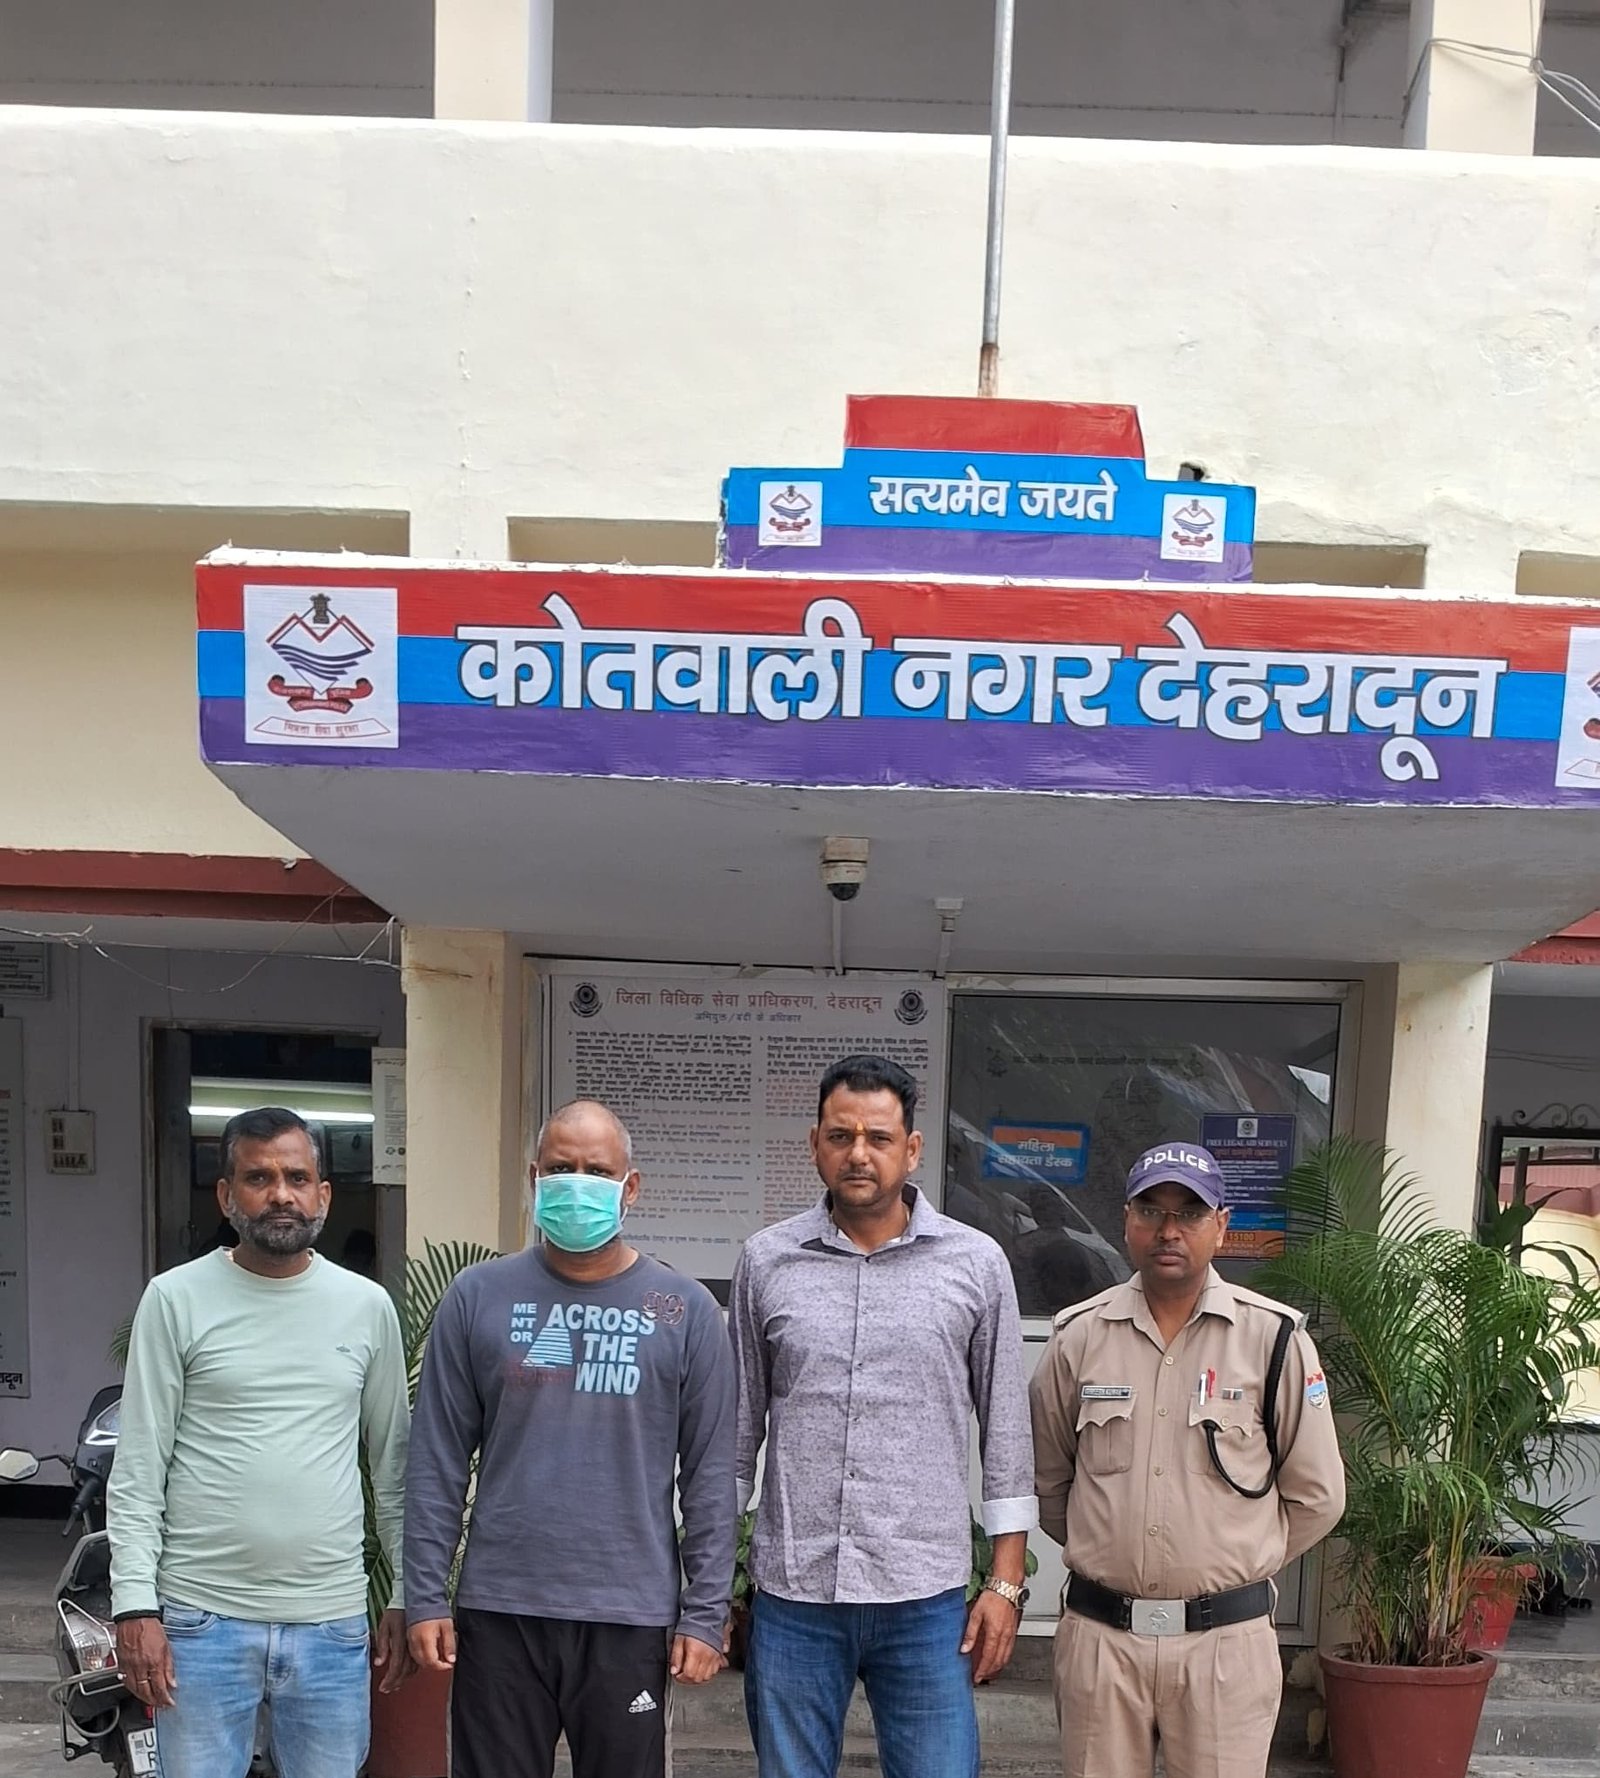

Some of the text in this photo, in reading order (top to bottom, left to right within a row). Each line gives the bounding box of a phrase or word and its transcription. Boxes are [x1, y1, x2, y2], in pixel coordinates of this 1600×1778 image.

[869, 465, 1119, 521] सत्यमेव जयते
[455, 592, 1510, 781] कोतवाली नगर देहरादून
[616, 987, 651, 1004] जिला
[660, 989, 704, 1006] विधिक
[711, 990, 739, 1006] सेवा
[826, 992, 882, 1014] देहरादून
[1017, 1137, 1055, 1152] महिला
[1143, 1149, 1210, 1173] POLICE
[1228, 1232, 1255, 1241] 15100
[546, 1303, 657, 1335] ACROSS
[582, 1333, 639, 1363] THE
[574, 1362, 641, 1396] WIND
